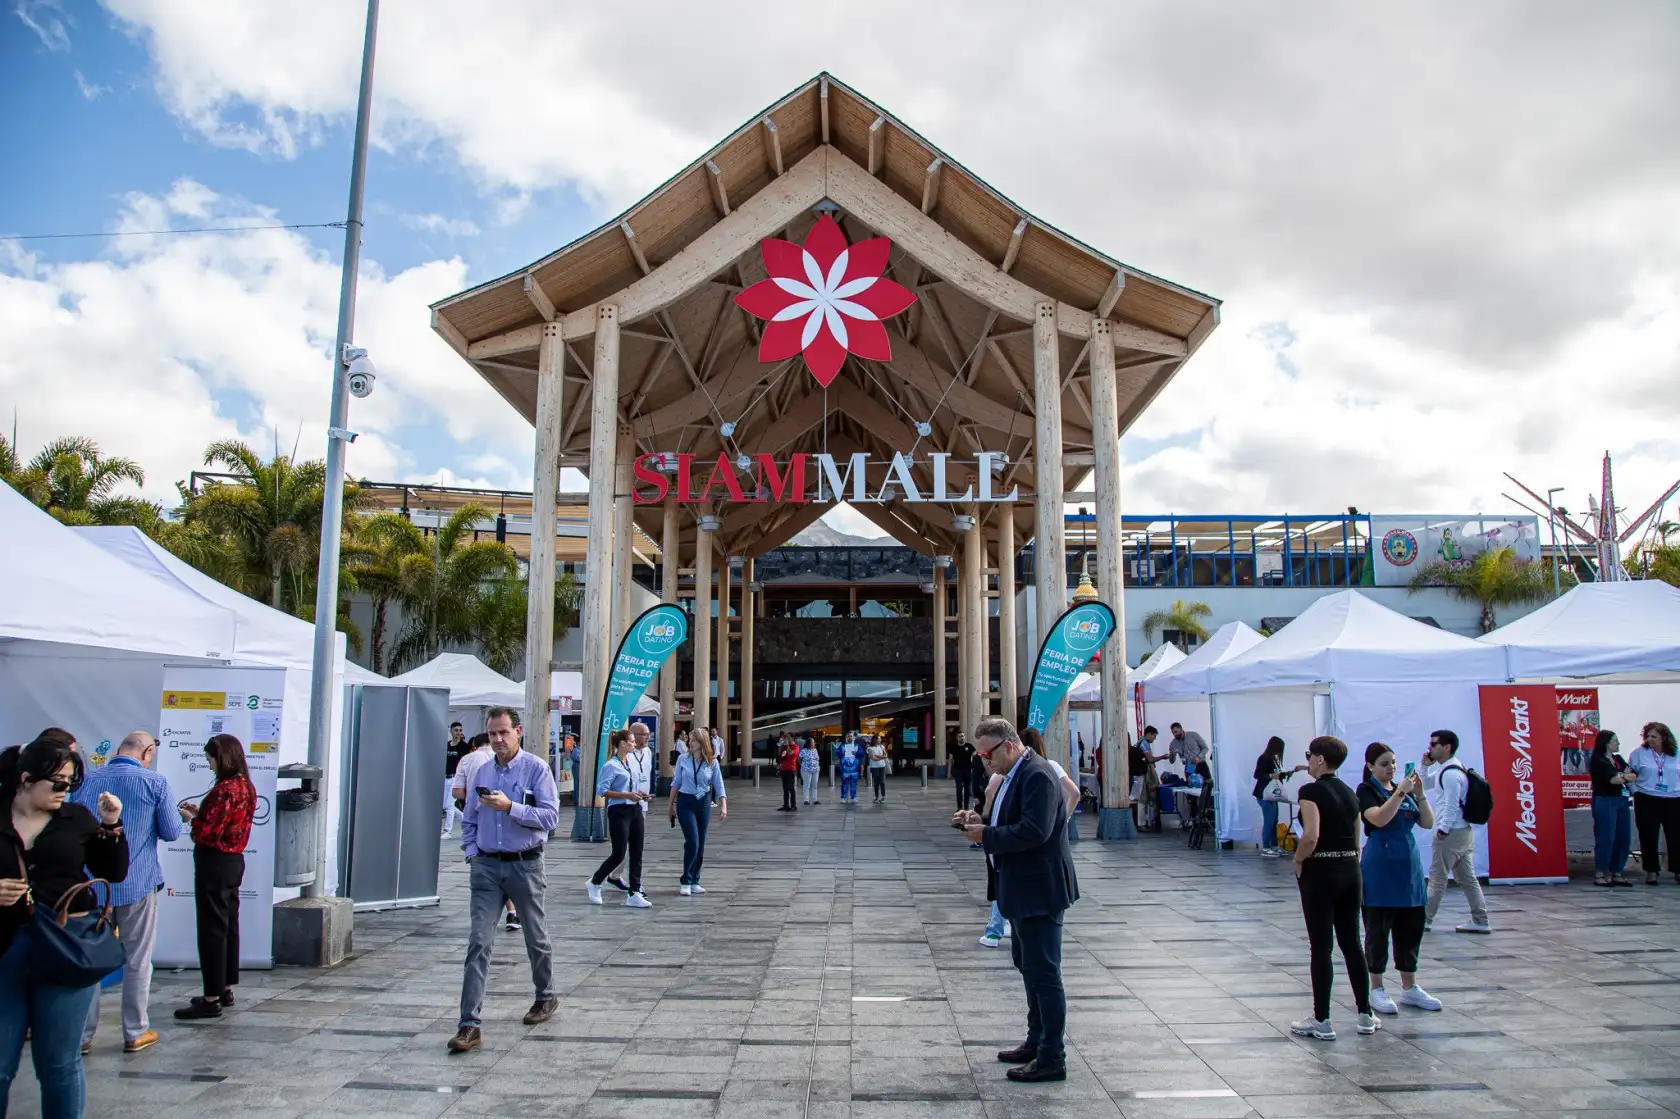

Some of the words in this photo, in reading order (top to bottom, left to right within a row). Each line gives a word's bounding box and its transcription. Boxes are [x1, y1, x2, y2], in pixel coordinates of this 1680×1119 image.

[645, 623, 675, 637] JOB
[1071, 619, 1100, 634] JOB
[644, 636, 673, 644] DATING
[1069, 631, 1097, 641] DATING
[619, 653, 645, 667] FERIA
[646, 660, 660, 669] DE
[1043, 648, 1069, 663] FERIA
[1071, 656, 1084, 667] DE
[615, 664, 653, 678] EMPLEO
[1040, 659, 1077, 675] EMPLEO
[1509, 696, 1532, 762] Markt
[1576, 782, 1588, 790] que
[1514, 780, 1538, 853] Media
